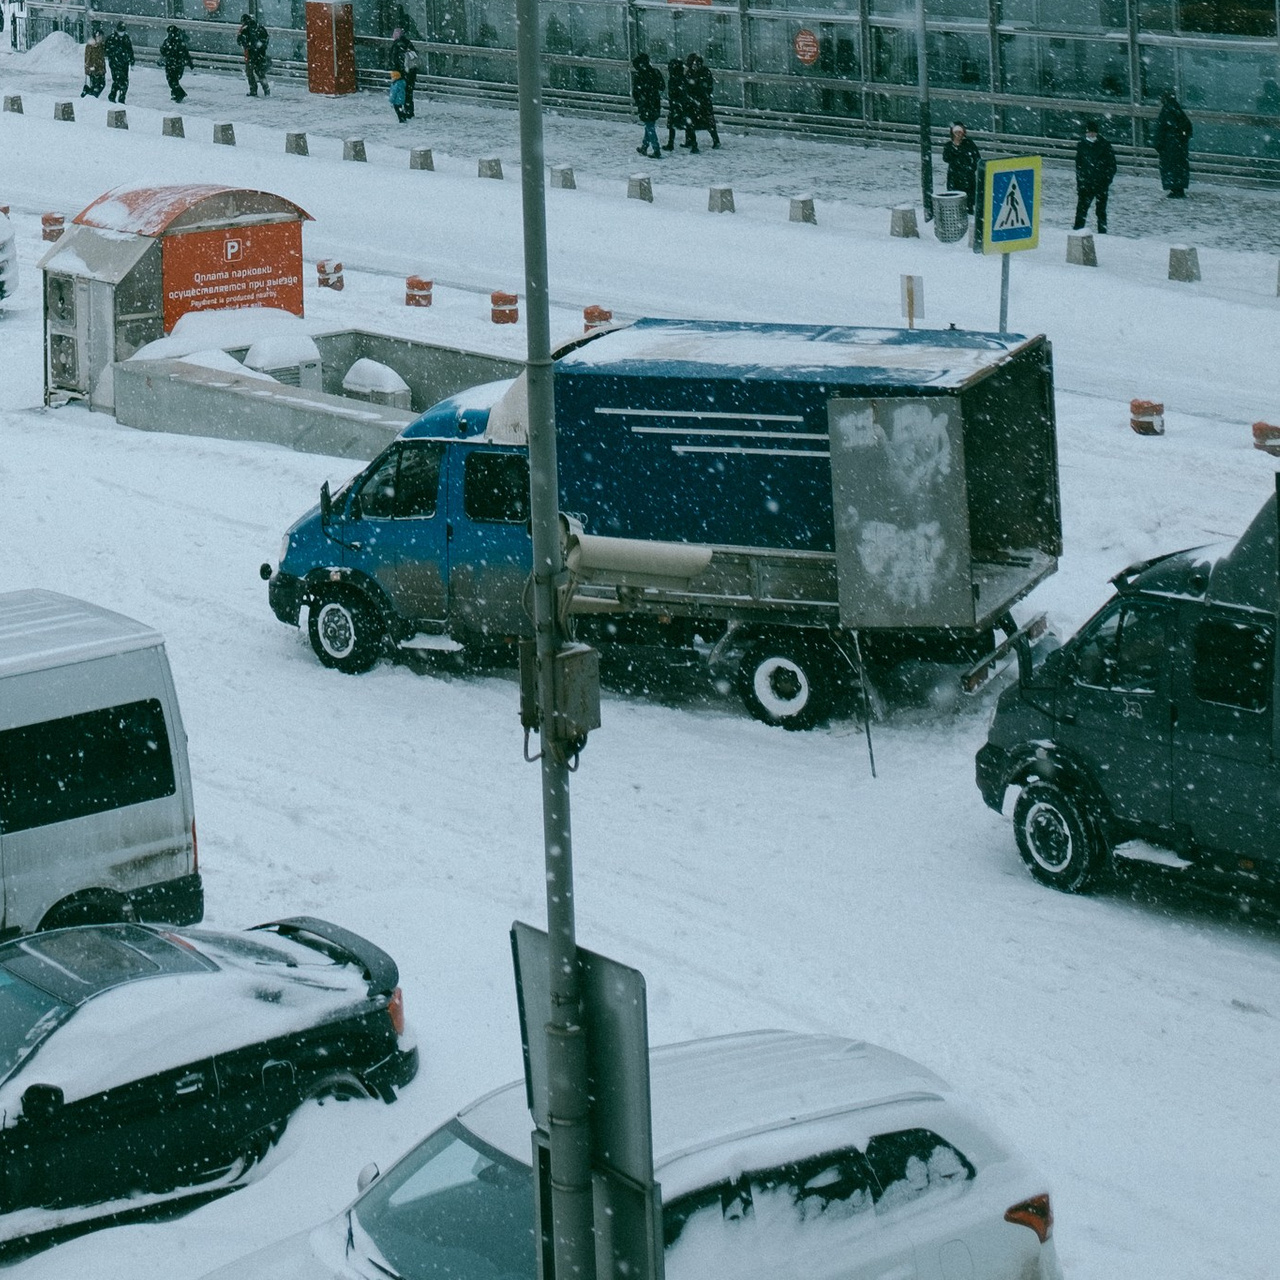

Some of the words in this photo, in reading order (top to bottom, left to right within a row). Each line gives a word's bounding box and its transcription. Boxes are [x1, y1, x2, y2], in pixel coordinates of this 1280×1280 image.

[226, 241, 239, 260] P
[194, 271, 229, 284] Оплата
[231, 266, 272, 279] парковки
[169, 282, 246, 299] осуществляется
[249, 279, 265, 291] при
[266, 275, 298, 287] выезде
